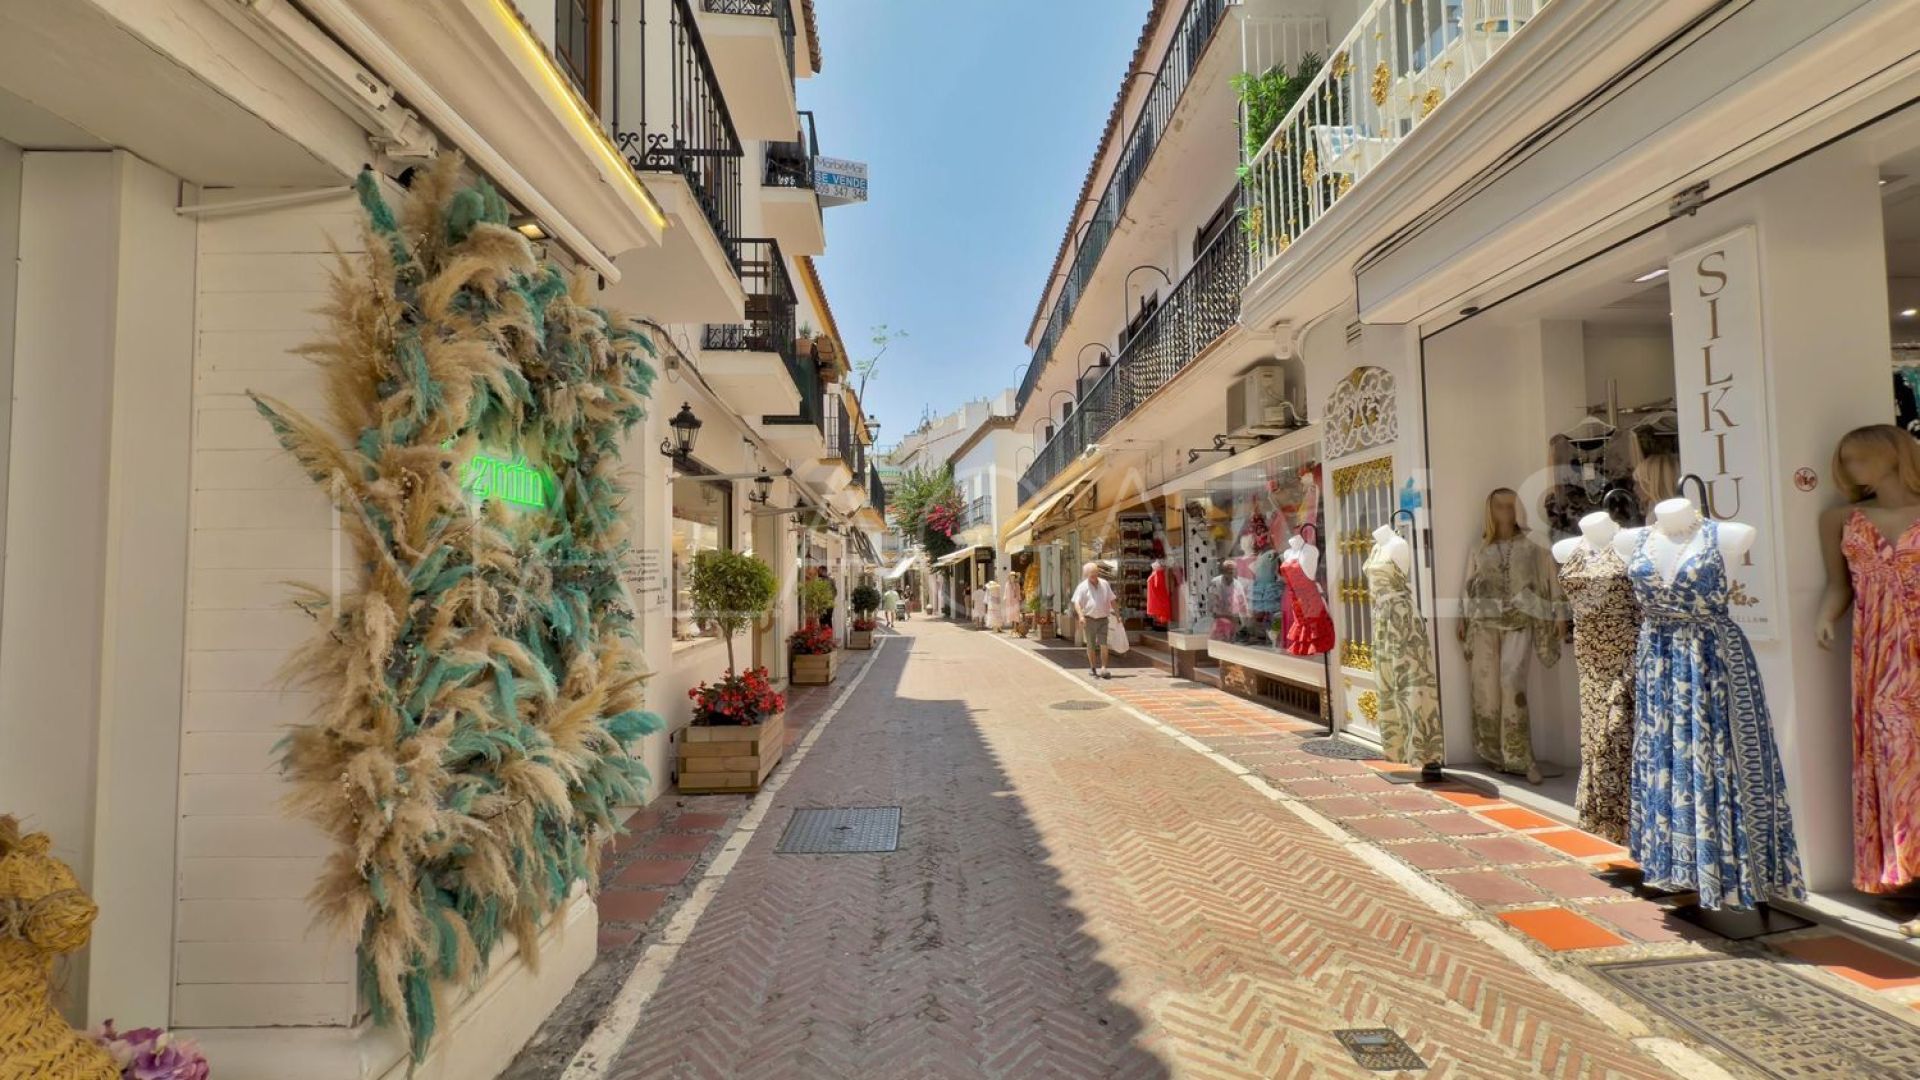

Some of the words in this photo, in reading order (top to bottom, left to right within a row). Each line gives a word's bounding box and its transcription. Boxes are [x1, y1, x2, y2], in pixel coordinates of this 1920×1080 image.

[815, 172, 828, 182] SE
[832, 174, 866, 189] VENDE
[834, 184, 848, 197] 347
[1697, 250, 1754, 566] SILKIU
